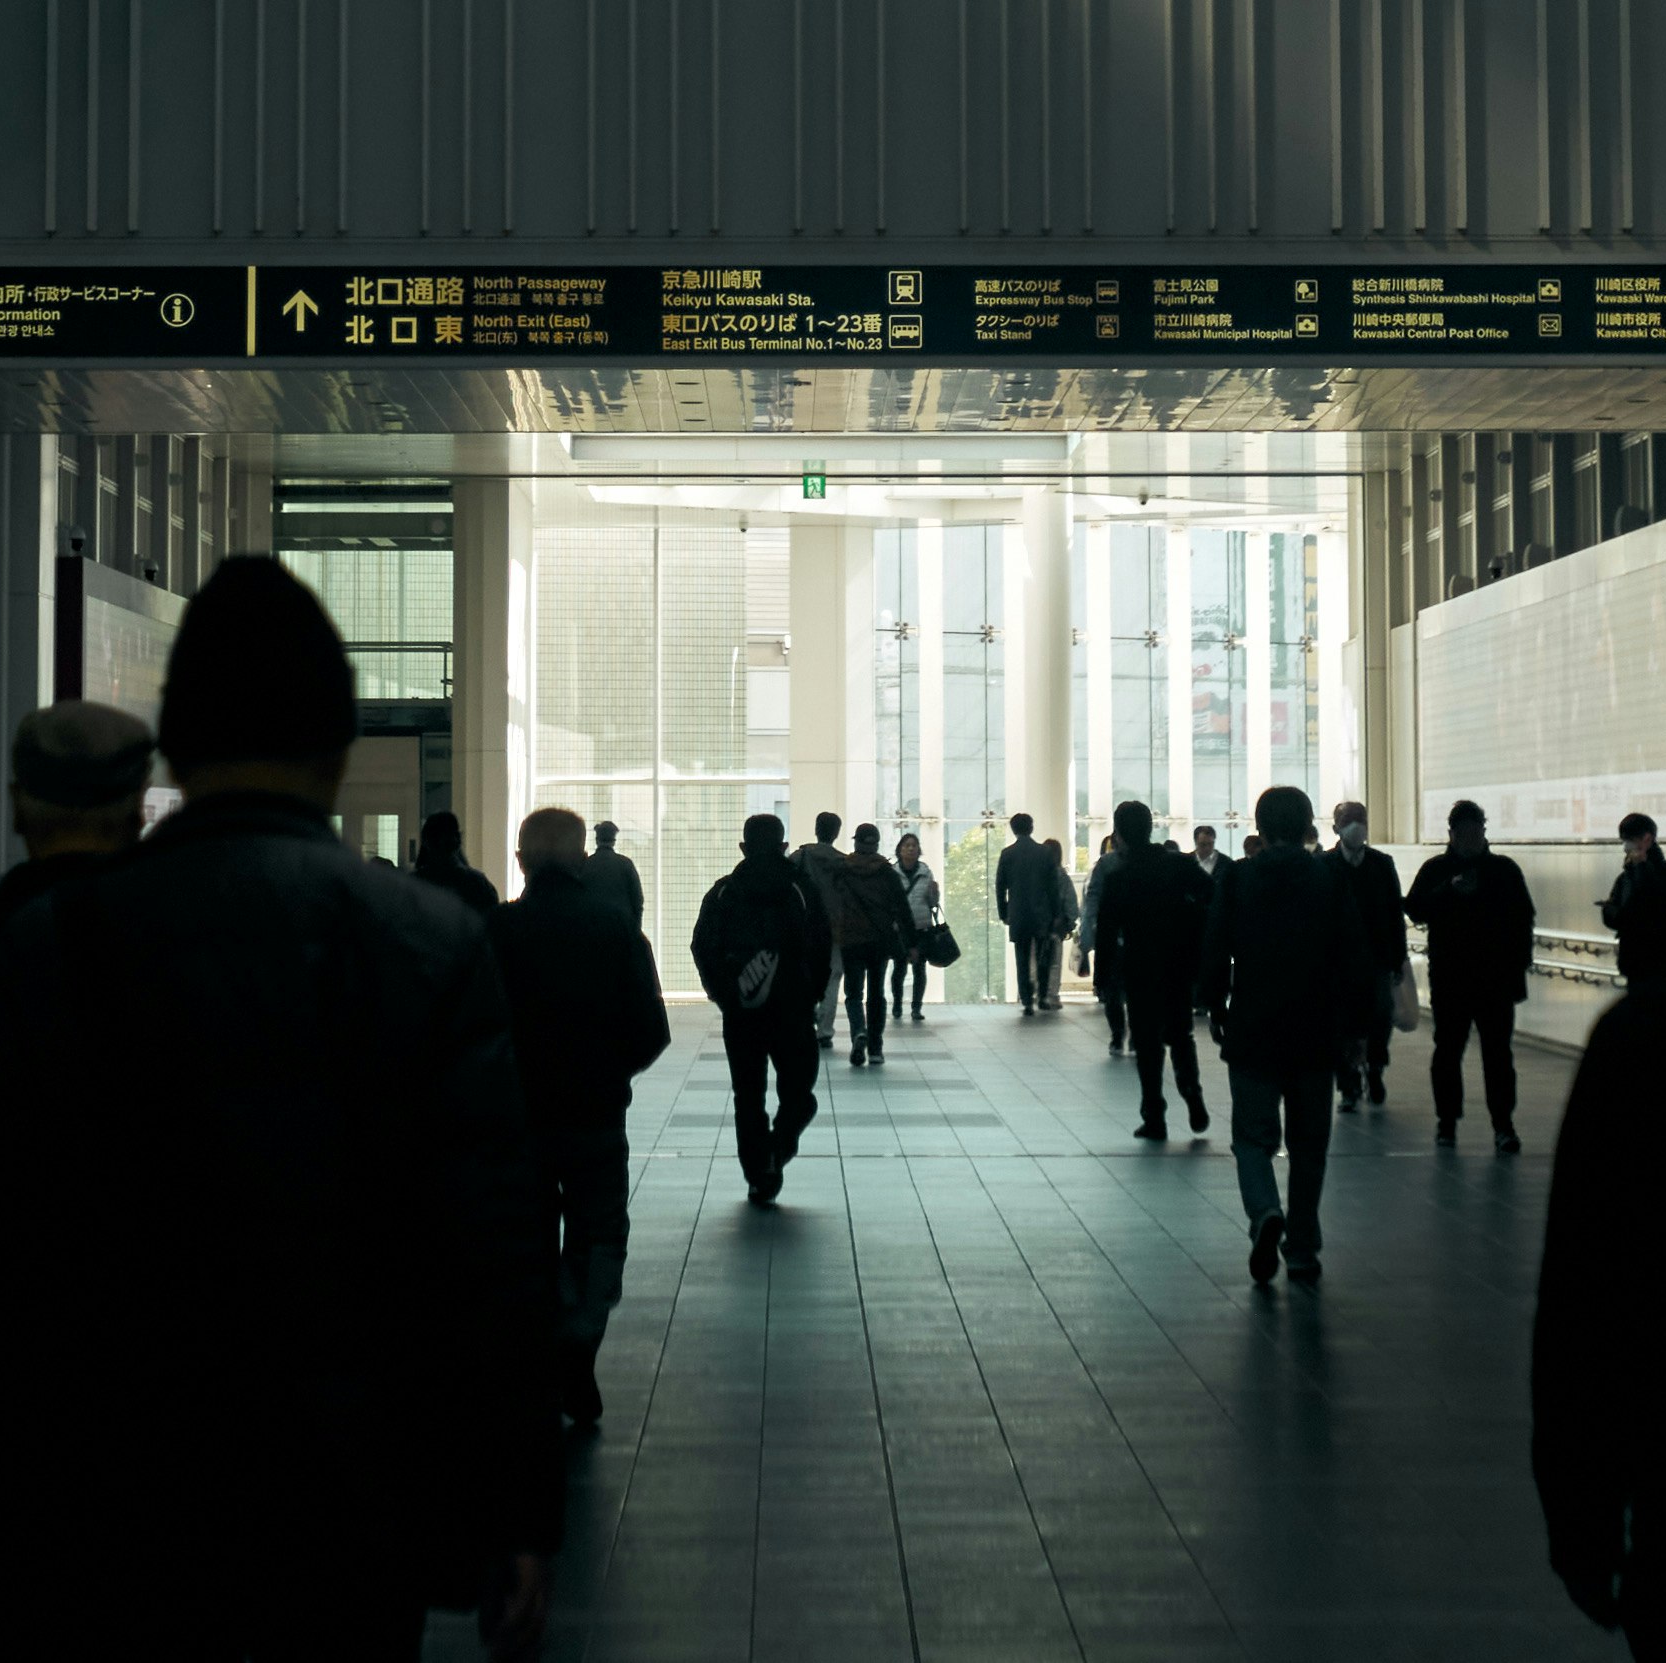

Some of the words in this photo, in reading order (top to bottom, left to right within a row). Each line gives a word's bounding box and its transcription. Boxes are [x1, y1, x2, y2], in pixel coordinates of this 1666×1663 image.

[474, 277, 514, 290] North
[518, 277, 607, 293] Passageway
[662, 270, 762, 289] 京急川崎駅
[1153, 279, 1219, 293] 富士見公園
[1352, 278, 1444, 292] 総合新川橋病院
[1596, 278, 1661, 292] 川崎区役所
[345, 277, 465, 306] 北口通路
[974, 280, 1061, 293] 高速バスのりば
[473, 293, 521, 306] 北口通道
[663, 293, 712, 308] Keikyu
[716, 293, 784, 307] Kawasaki
[788, 293, 815, 307] Sta.
[975, 294, 1041, 307] Expressway
[1044, 294, 1065, 305] Bus
[1068, 294, 1093, 307] Stop
[1153, 294, 1188, 306] Fujimi
[1190, 294, 1216, 305] Park
[1353, 293, 1406, 306] Synthesis
[1409, 293, 1489, 304] Shinkawabashi
[1492, 293, 1536, 306] Hospital
[1596, 293, 1643, 304] Kawasaki
[474, 315, 514, 328] North
[518, 315, 545, 328] Exit
[549, 314, 591, 329] (East)
[662, 314, 797, 333] 東口バスのりば
[975, 314, 1060, 328] タクシーのりば
[1154, 314, 1233, 327] 市立川崎病院
[1353, 313, 1445, 327] 川崎中央郵便局
[1596, 313, 1662, 327] 川崎市役所
[22, 325, 55, 338] 안내소
[975, 329, 998, 340] Taxi
[1001, 329, 1032, 340] Stand
[1154, 328, 1200, 340] Kawasaki
[1203, 328, 1250, 341] Municipal
[1252, 328, 1293, 341] Hospital
[1353, 328, 1405, 339] Kawasaki
[1408, 328, 1447, 339] Central
[1449, 328, 1474, 339] Post
[1477, 328, 1509, 339] Office
[1596, 328, 1648, 339] Kawasaki
[662, 338, 690, 350] East
[694, 338, 718, 350] Exit
[722, 338, 746, 350] Bus
[749, 337, 803, 350] Terminal
[738, 948, 774, 998] NIKE
